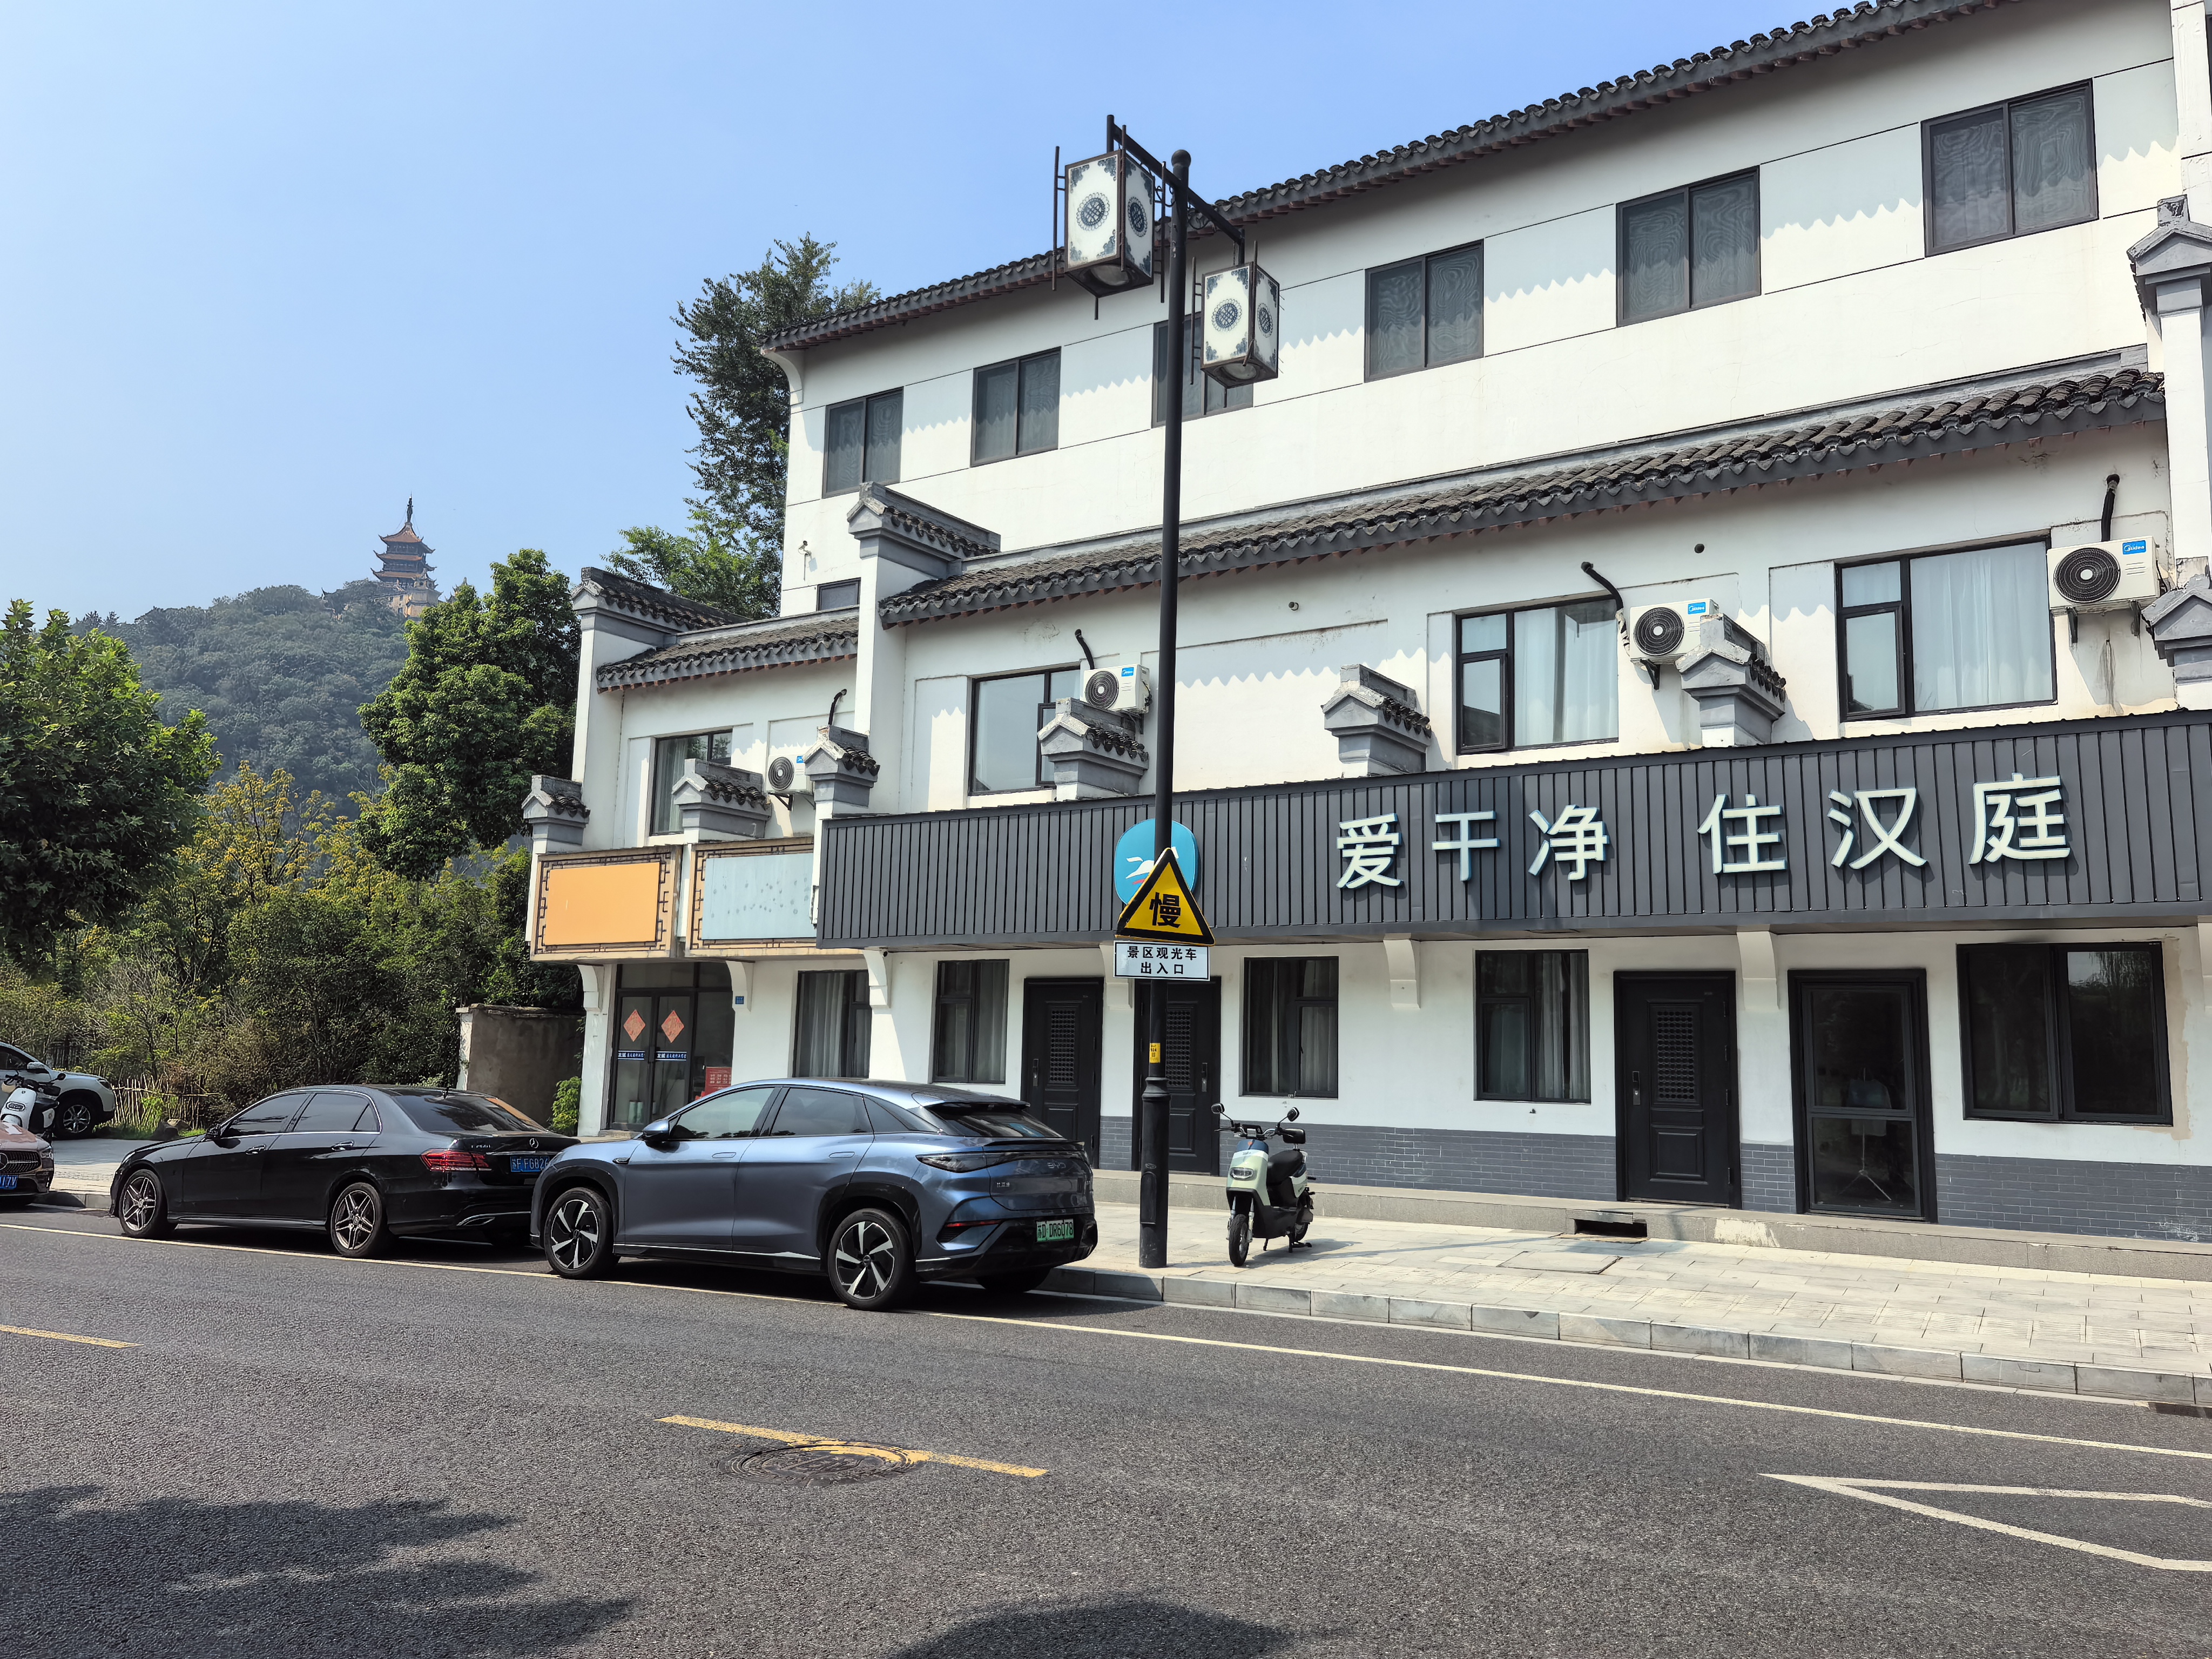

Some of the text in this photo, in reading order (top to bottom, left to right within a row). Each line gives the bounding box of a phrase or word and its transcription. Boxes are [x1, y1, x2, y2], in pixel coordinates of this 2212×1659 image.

[1336, 772, 2071, 889] 爱干净 住汉庭
[1149, 892, 1181, 928] 慢
[1127, 946, 1197, 960] 景区观光车
[1141, 962, 1184, 975] 出入口
[0, 1176, 17, 1186] 17Y
